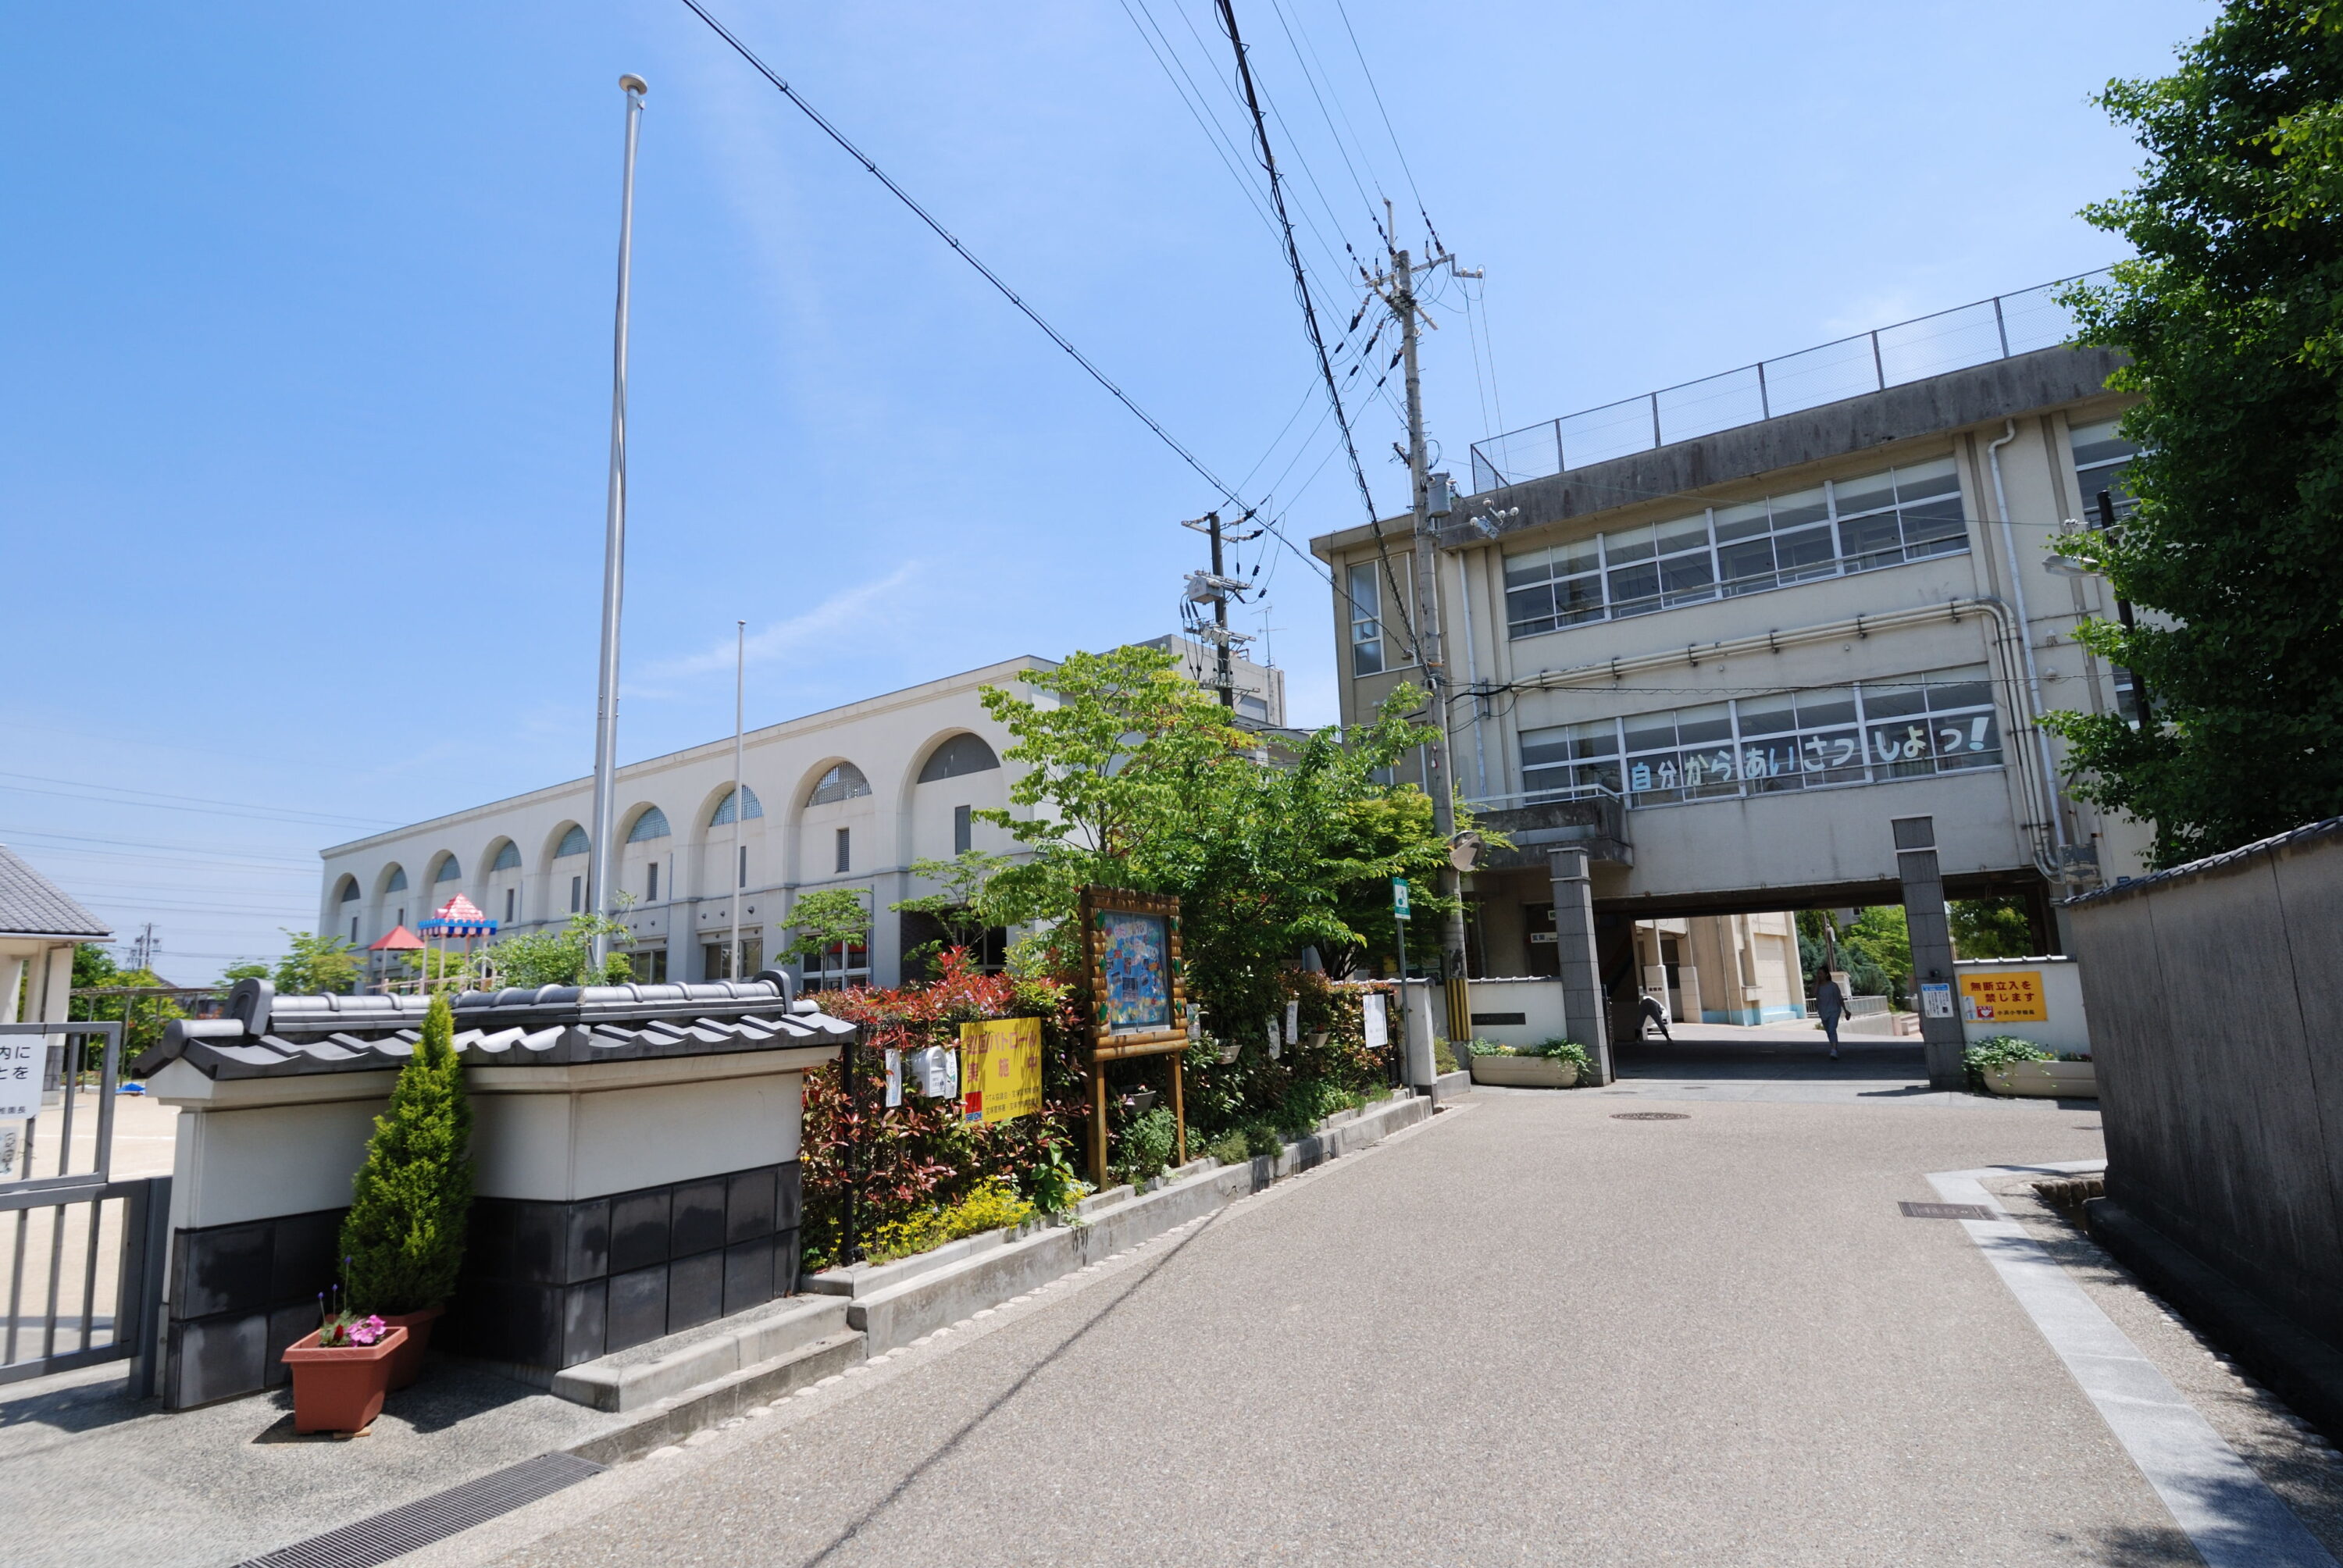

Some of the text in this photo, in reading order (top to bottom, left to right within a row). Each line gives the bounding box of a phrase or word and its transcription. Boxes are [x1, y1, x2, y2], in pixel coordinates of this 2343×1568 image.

[1970, 981, 2031, 991] 無断立入を
[1985, 992, 2035, 1003] 禁じます
